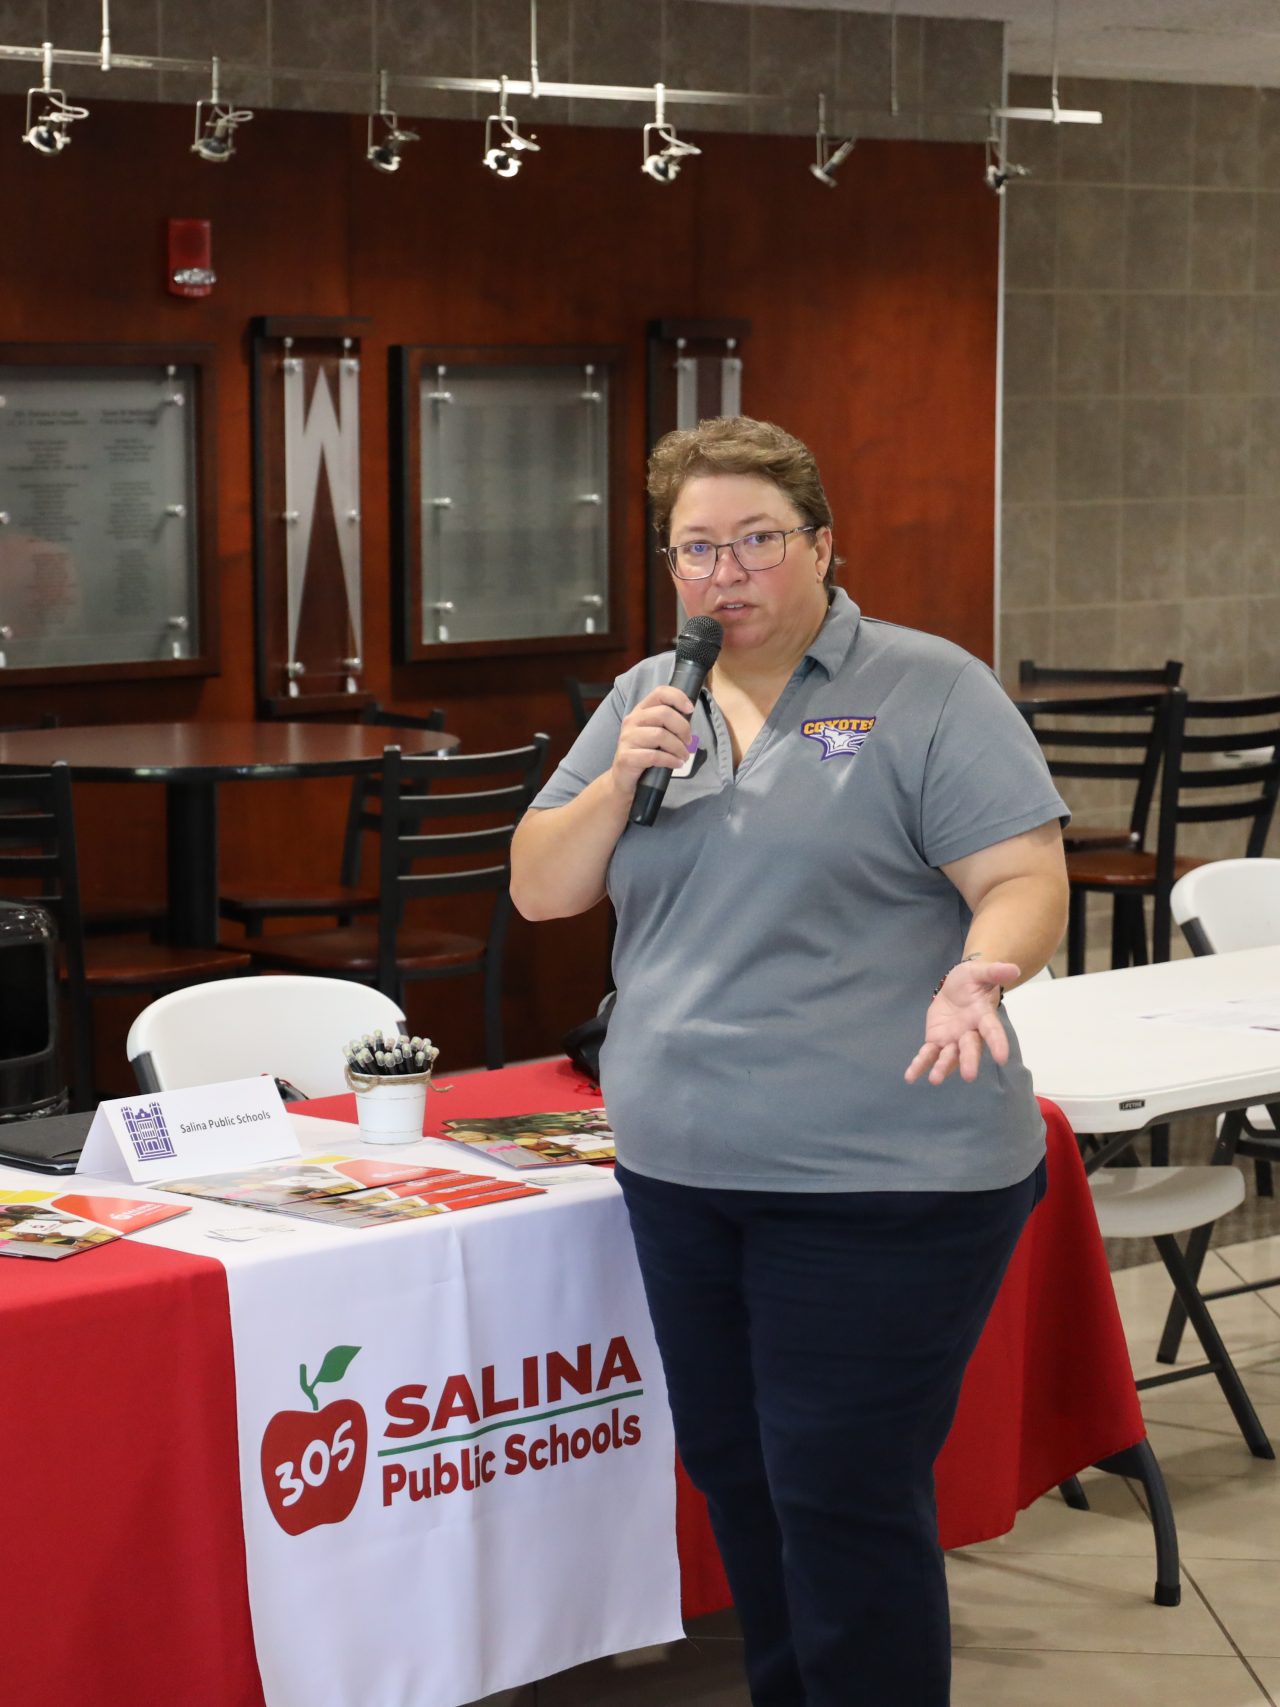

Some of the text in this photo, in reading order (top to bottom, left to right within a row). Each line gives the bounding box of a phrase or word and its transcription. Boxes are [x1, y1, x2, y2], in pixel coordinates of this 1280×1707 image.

[284, 358, 362, 678] W
[180, 1110, 271, 1134] Salina Public Schools
[383, 1335, 642, 1439] SALINA
[274, 1419, 356, 1507] 305
[382, 1407, 642, 1508] Public Schools
